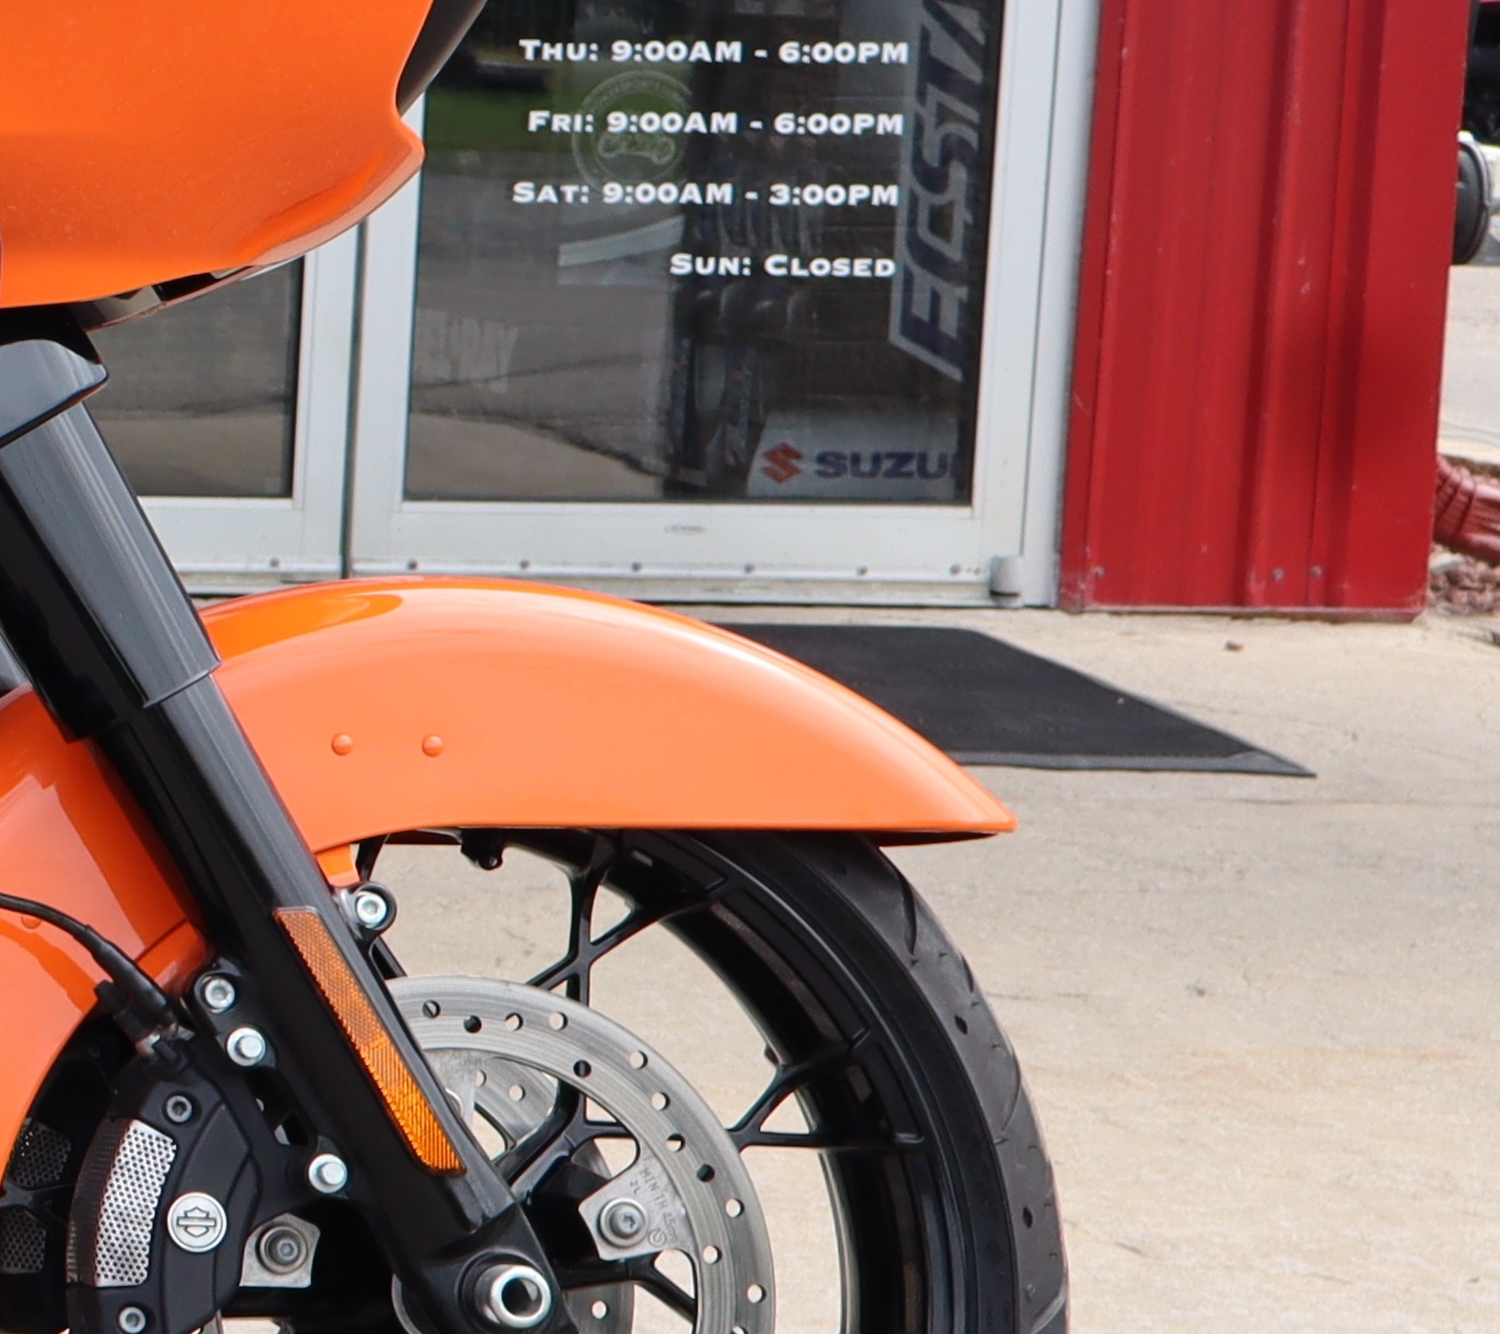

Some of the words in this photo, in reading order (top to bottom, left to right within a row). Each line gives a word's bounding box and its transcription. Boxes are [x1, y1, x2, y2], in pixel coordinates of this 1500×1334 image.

[610, 39, 743, 63] 9:00AM
[778, 41, 909, 64] 6:00PM
[606, 110, 738, 134] 9:00AM
[773, 112, 904, 136] 6:00PM
[602, 181, 734, 205] 9:00AM
[768, 183, 899, 207] 3:00PM
[815, 450, 953, 480] SUZU
